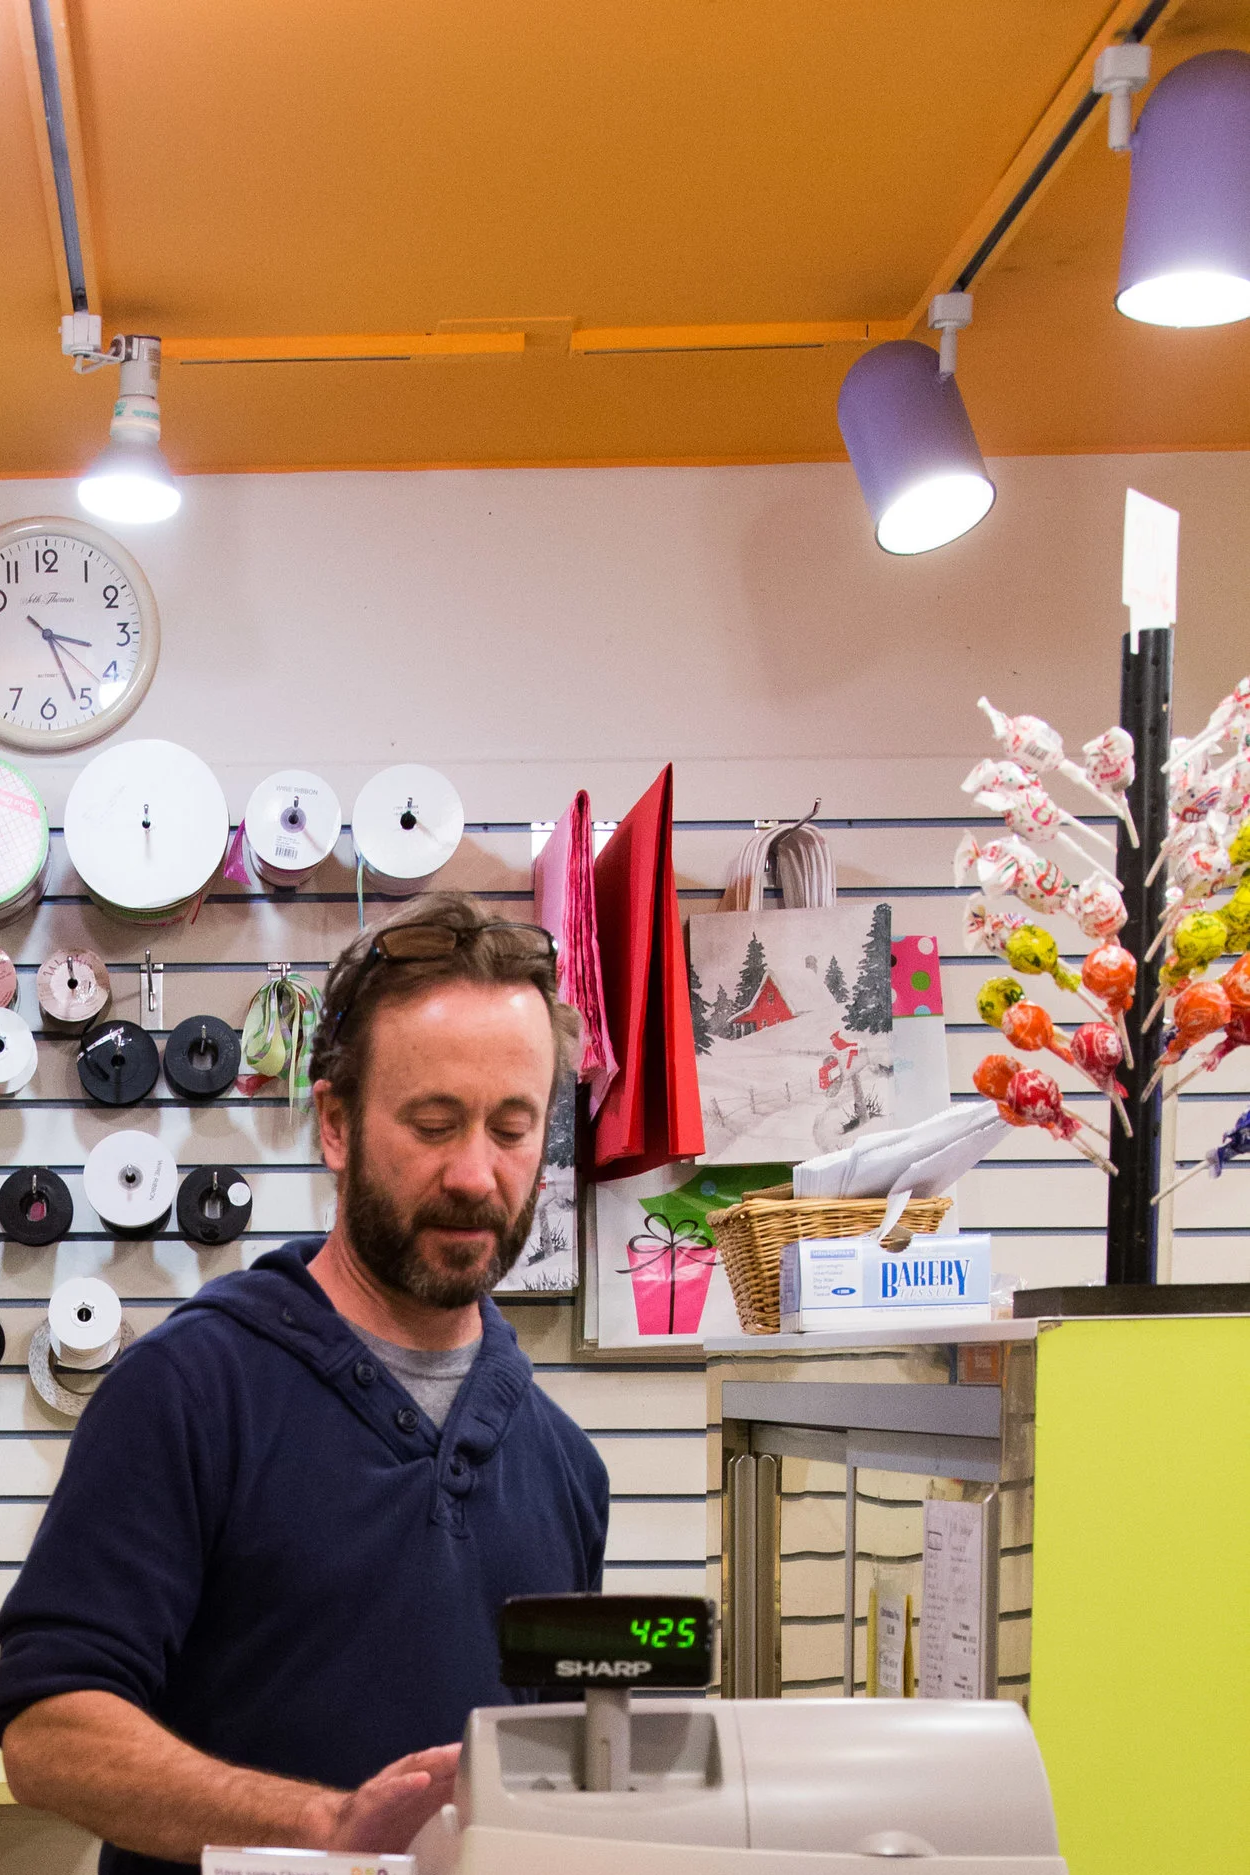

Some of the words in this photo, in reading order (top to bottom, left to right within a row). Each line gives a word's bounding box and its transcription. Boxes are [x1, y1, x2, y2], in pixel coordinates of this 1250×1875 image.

[6, 561, 19, 584] 11
[35, 549, 58, 573] 12
[83, 560, 88, 583] 1
[103, 585, 119, 609] 2
[116, 622, 131, 647] 3
[102, 660, 119, 683] 4
[9, 687, 23, 711] 7
[40, 697, 57, 720] 6
[79, 687, 93, 710] 5
[881, 1259, 969, 1299] BAKERY
[555, 1659, 652, 1678] SHARP
